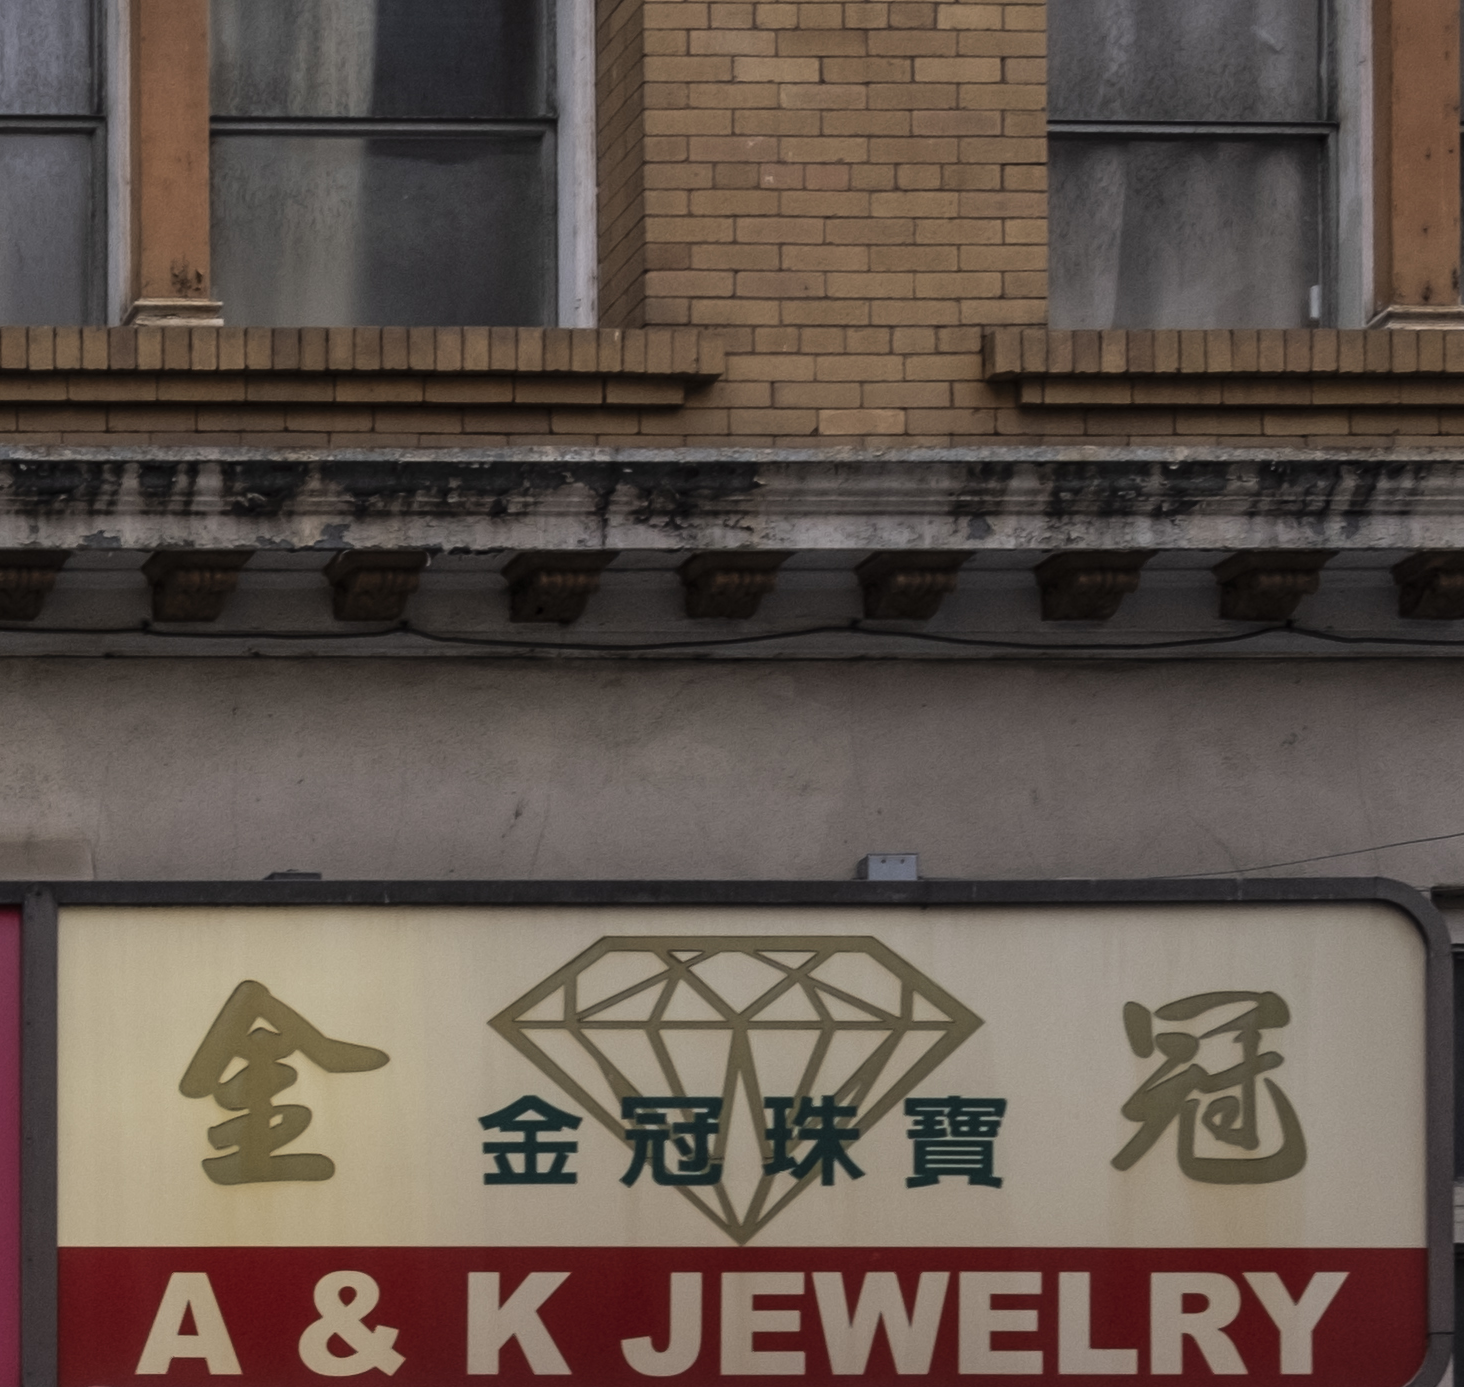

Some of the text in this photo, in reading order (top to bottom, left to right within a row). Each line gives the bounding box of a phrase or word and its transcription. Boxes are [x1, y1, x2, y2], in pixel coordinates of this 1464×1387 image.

[179, 980, 390, 1186] 金
[478, 1095, 1007, 1189] 金冠珠寶
[136, 1271, 1349, 1376] A & K JEWELRY
